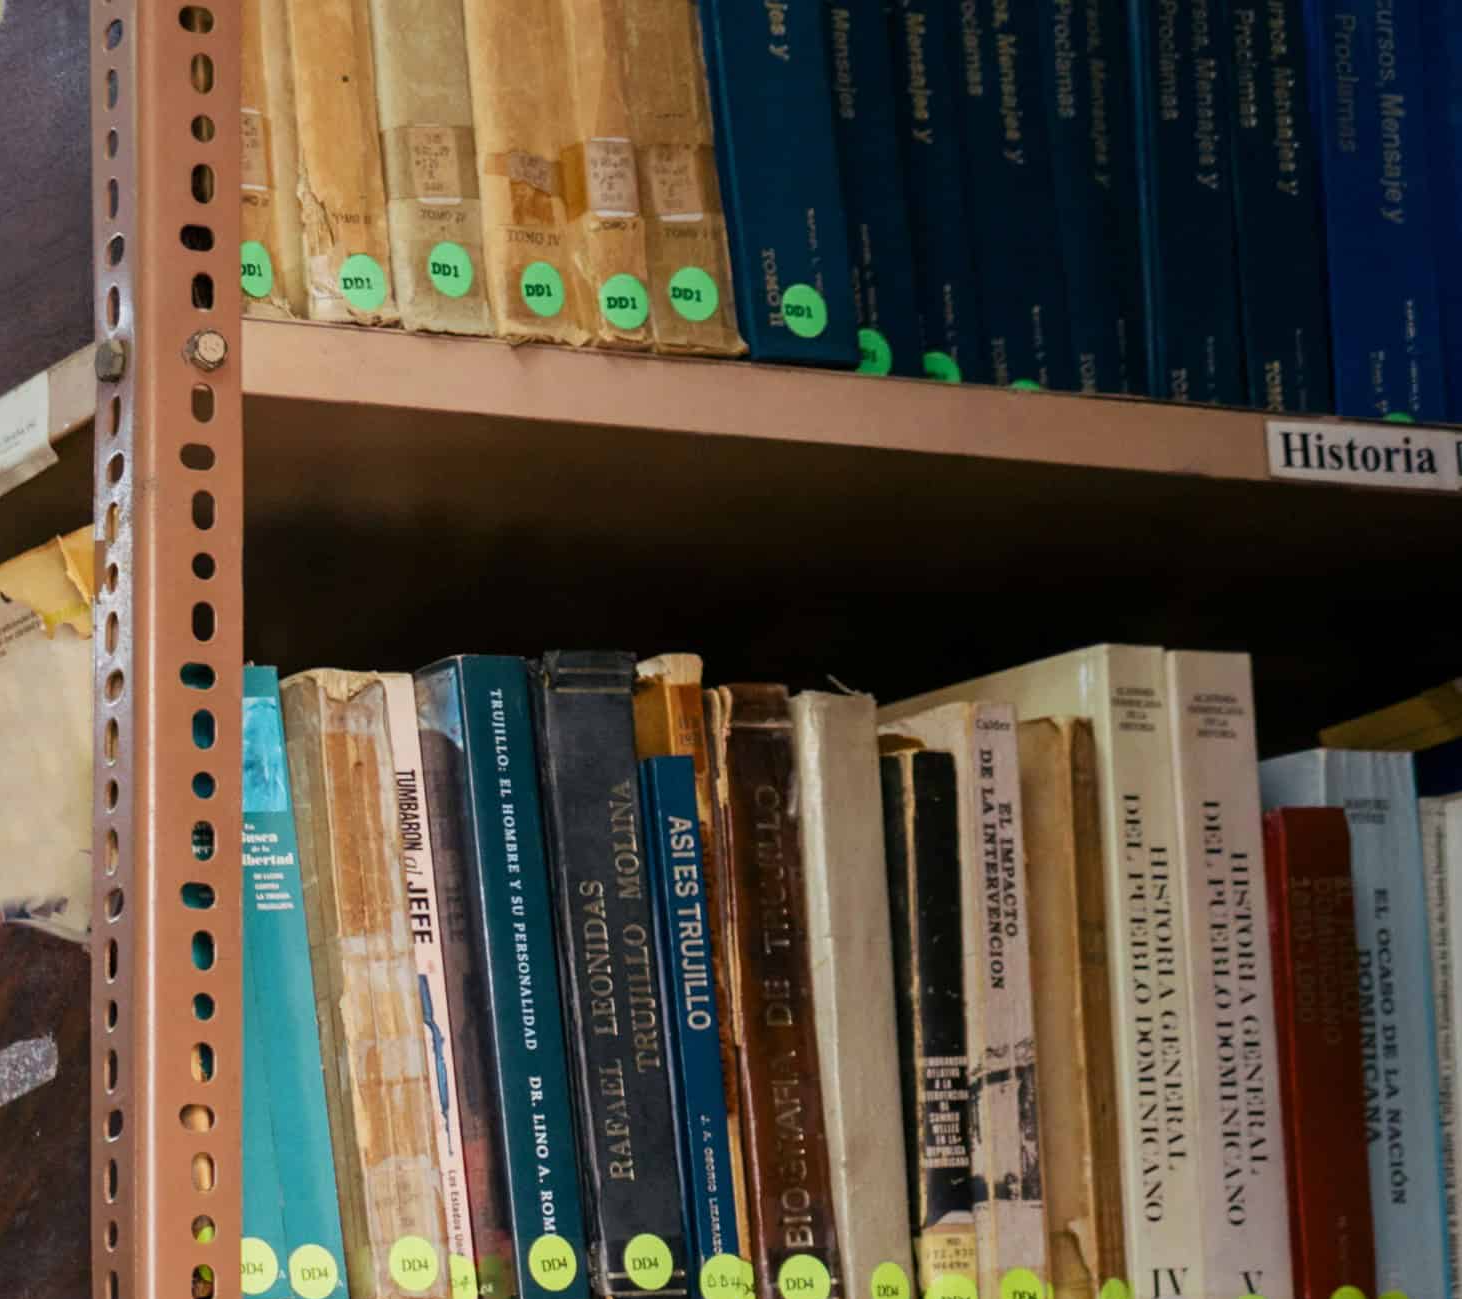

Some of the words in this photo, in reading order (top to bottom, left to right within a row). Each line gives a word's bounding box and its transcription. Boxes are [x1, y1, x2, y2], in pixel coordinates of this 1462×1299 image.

[343, 275, 373, 291] DD1
[431, 261, 459, 278] DD1
[525, 283, 553, 297] DD1
[606, 296, 638, 310] DD1
[671, 287, 702, 303] DD1
[785, 303, 812, 319] DD1
[1281, 431, 1437, 474] Historia
[491, 689, 510, 772] TRUJILLO:
[499, 778, 512, 797] EL
[979, 748, 994, 781] DE
[395, 769, 423, 851] TUMBARON
[981, 786, 995, 813] LA
[999, 801, 1013, 826] EL
[502, 804, 520, 873] HOMBRE
[611, 778, 643, 899] MOLINA
[667, 815, 697, 860] ASI
[1123, 794, 1143, 861] DEL
[1203, 801, 1224, 868] DEL
[510, 878, 522, 888] Y
[512, 894, 524, 916] SU
[673, 865, 700, 898] ES
[983, 819, 1006, 990] INTERVENCION
[999, 831, 1019, 938] IMPACTO
[406, 881, 434, 945] JEFE
[1150, 847, 1176, 1000] HISTORIA
[1231, 853, 1257, 1004] HISTORIA
[580, 880, 618, 1037] LEONIDAS
[1128, 872, 1153, 1005] PUEBLO
[1208, 879, 1233, 1010] PUEBLO
[513, 922, 537, 1051] PERSONALIDAD
[677, 903, 711, 1032] TRUJILLO
[620, 923, 660, 1073] TRUJILLO
[768, 979, 793, 1027] DE
[1358, 946, 1383, 1147] DOMINICANA
[528, 1076, 543, 1106] DR.
[1160, 1010, 1188, 1170] GENERAL
[1241, 1015, 1268, 1175] GENERAL
[532, 1112, 549, 1159] LINO
[597, 1057, 634, 1182] RAFAEL
[1135, 1015, 1163, 1223] DOMINICANO
[1214, 1021, 1247, 1227] DOMINICANO
[773, 1049, 815, 1249] BIOGRAFIA
[536, 1167, 551, 1186] A.
[540, 1189, 557, 1235] ROM
[301, 1267, 329, 1280] DD4
[402, 1258, 429, 1272] DD4
[542, 1259, 567, 1272] DD4
[632, 1257, 659, 1271] DD4
[786, 1277, 814, 1292] DD4
[1152, 1267, 1189, 1299] IV
